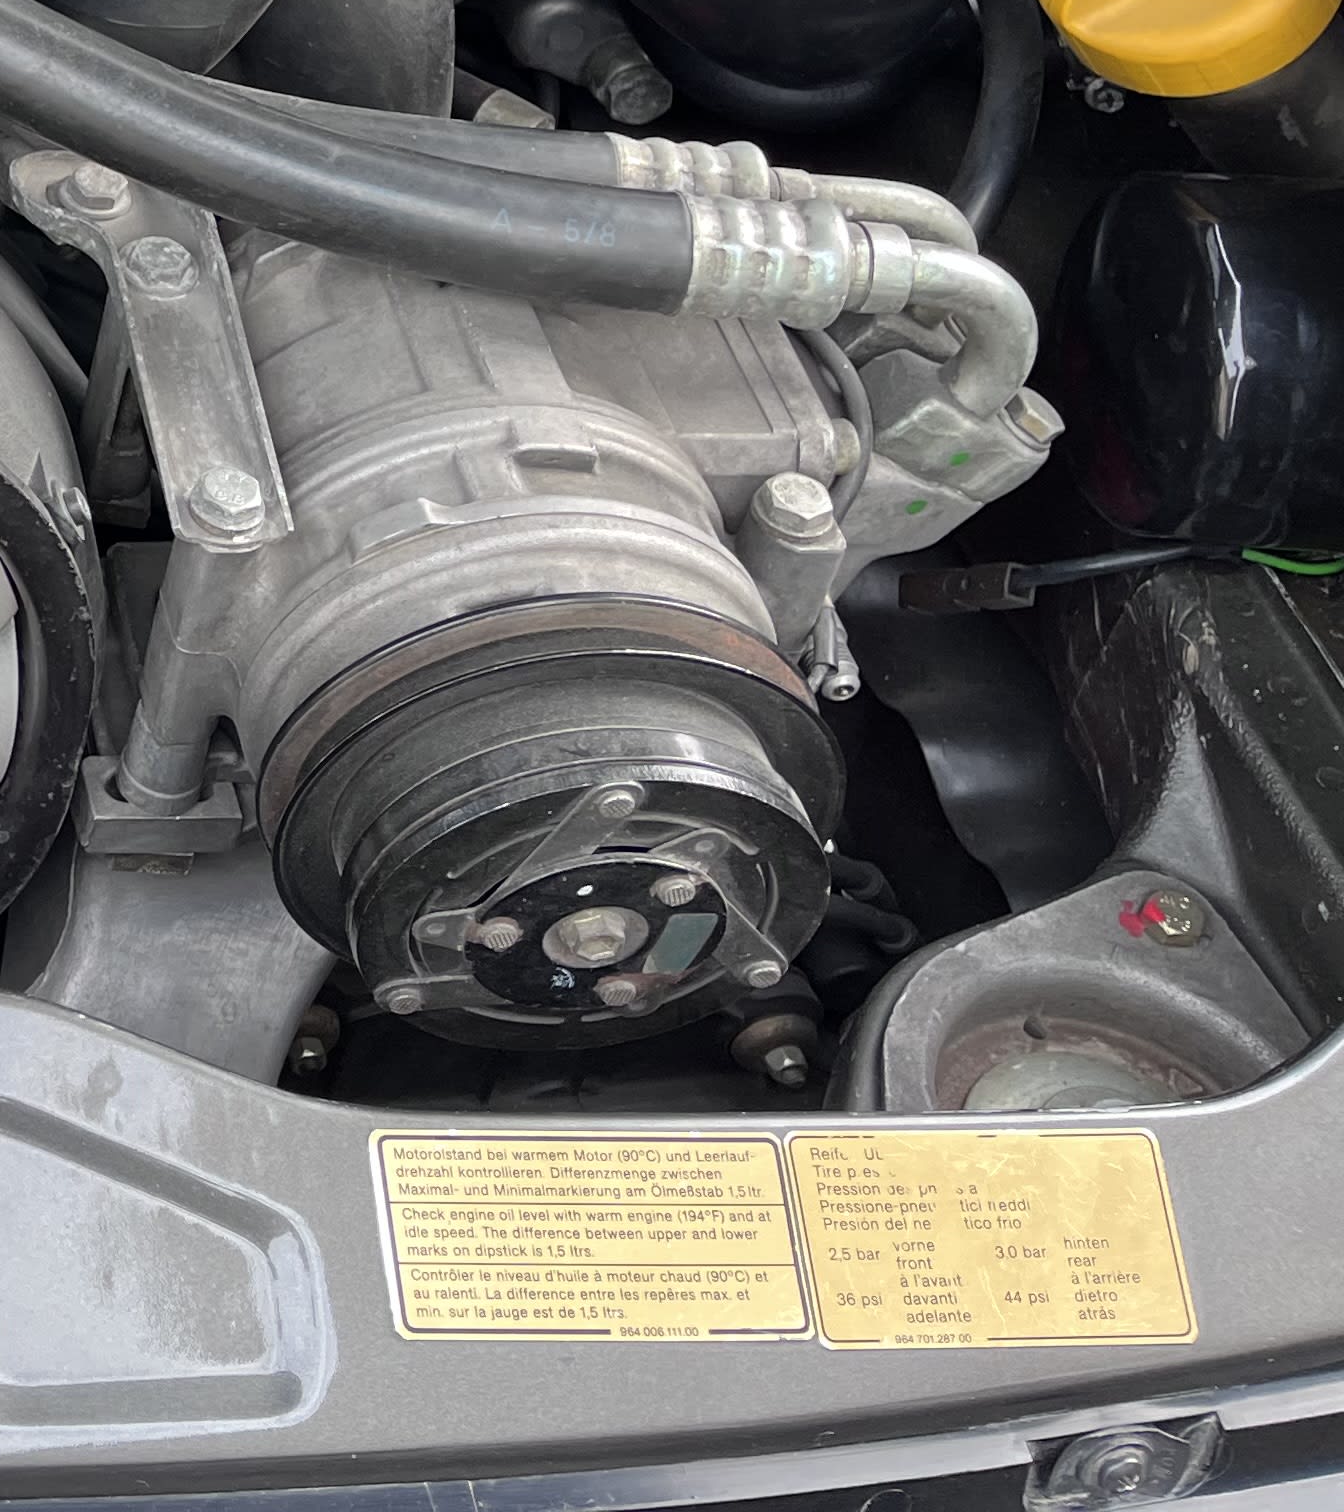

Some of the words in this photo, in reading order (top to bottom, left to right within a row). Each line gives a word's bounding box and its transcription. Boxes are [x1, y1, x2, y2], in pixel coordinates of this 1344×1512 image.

[490, 207, 513, 234] A
[564, 216, 616, 248] 5/8
[487, 1149, 507, 1160] bei
[512, 1152, 568, 1161] warmem
[574, 1150, 612, 1161] Motor
[618, 1150, 660, 1163] (90°C)
[666, 1150, 690, 1162] und
[396, 1166, 453, 1177] drehzahl
[550, 1167, 656, 1182] Differenzmenge
[661, 1168, 722, 1180] zwischen
[812, 1165, 841, 1178] Tire
[399, 1183, 458, 1195] Maximal-
[464, 1184, 488, 1196] und
[494, 1184, 620, 1199] Minimalmarkierung
[626, 1188, 646, 1197] am
[651, 1183, 723, 1198] Ölmeßstab
[816, 1182, 880, 1195] Pression
[402, 1208, 445, 1220] Check
[450, 1211, 494, 1223] engine
[499, 1209, 514, 1221] oil
[519, 1210, 550, 1221] level
[554, 1210, 581, 1221] with
[586, 1212, 622, 1222] warm
[628, 1212, 672, 1224] engine
[678, 1210, 724, 1224] (194°F)
[729, 1210, 754, 1222] and
[758, 1211, 771, 1222] at
[823, 1218, 879, 1230] Presión
[885, 1214, 907, 1230] del
[405, 1226, 428, 1238] idle
[482, 1226, 507, 1238] The
[585, 1228, 643, 1239] between
[648, 1230, 687, 1242] upper
[692, 1228, 716, 1240] and
[721, 1228, 758, 1240] lower
[891, 1240, 935, 1253] vorne
[1064, 1237, 1109, 1249] hinten
[408, 1244, 448, 1256] marks
[453, 1247, 470, 1256] on
[475, 1244, 528, 1258] dipstick
[532, 1245, 542, 1257] is
[829, 1248, 851, 1262] 2,5
[856, 1248, 880, 1260] bar
[1022, 1246, 1046, 1258] bar
[896, 1256, 933, 1270] front
[1068, 1257, 1096, 1267] rear
[411, 1268, 474, 1281] Contrôler
[479, 1270, 491, 1281] le
[496, 1270, 540, 1282] niveau
[545, 1270, 588, 1282] d'huile
[594, 1270, 602, 1282] à
[607, 1271, 654, 1282] moteur
[660, 1270, 701, 1282] chaud
[706, 1270, 750, 1284] (90°C)
[756, 1272, 768, 1282] et
[414, 1290, 430, 1299] au
[485, 1288, 502, 1300] La
[580, 1290, 615, 1300] entre
[620, 1288, 639, 1300] les
[737, 1289, 750, 1300] et
[837, 1293, 856, 1306] 36
[861, 1296, 882, 1308] psi
[904, 1292, 957, 1305] davanti
[1005, 1291, 1021, 1303] 44
[1028, 1293, 1049, 1306] psi
[1075, 1289, 1117, 1302] dietro
[449, 1308, 469, 1318] sur
[474, 1306, 486, 1318] la
[491, 1308, 528, 1320] jauge
[533, 1307, 554, 1318] est
[558, 1306, 575, 1318] de
[907, 1310, 971, 1323] adelante
